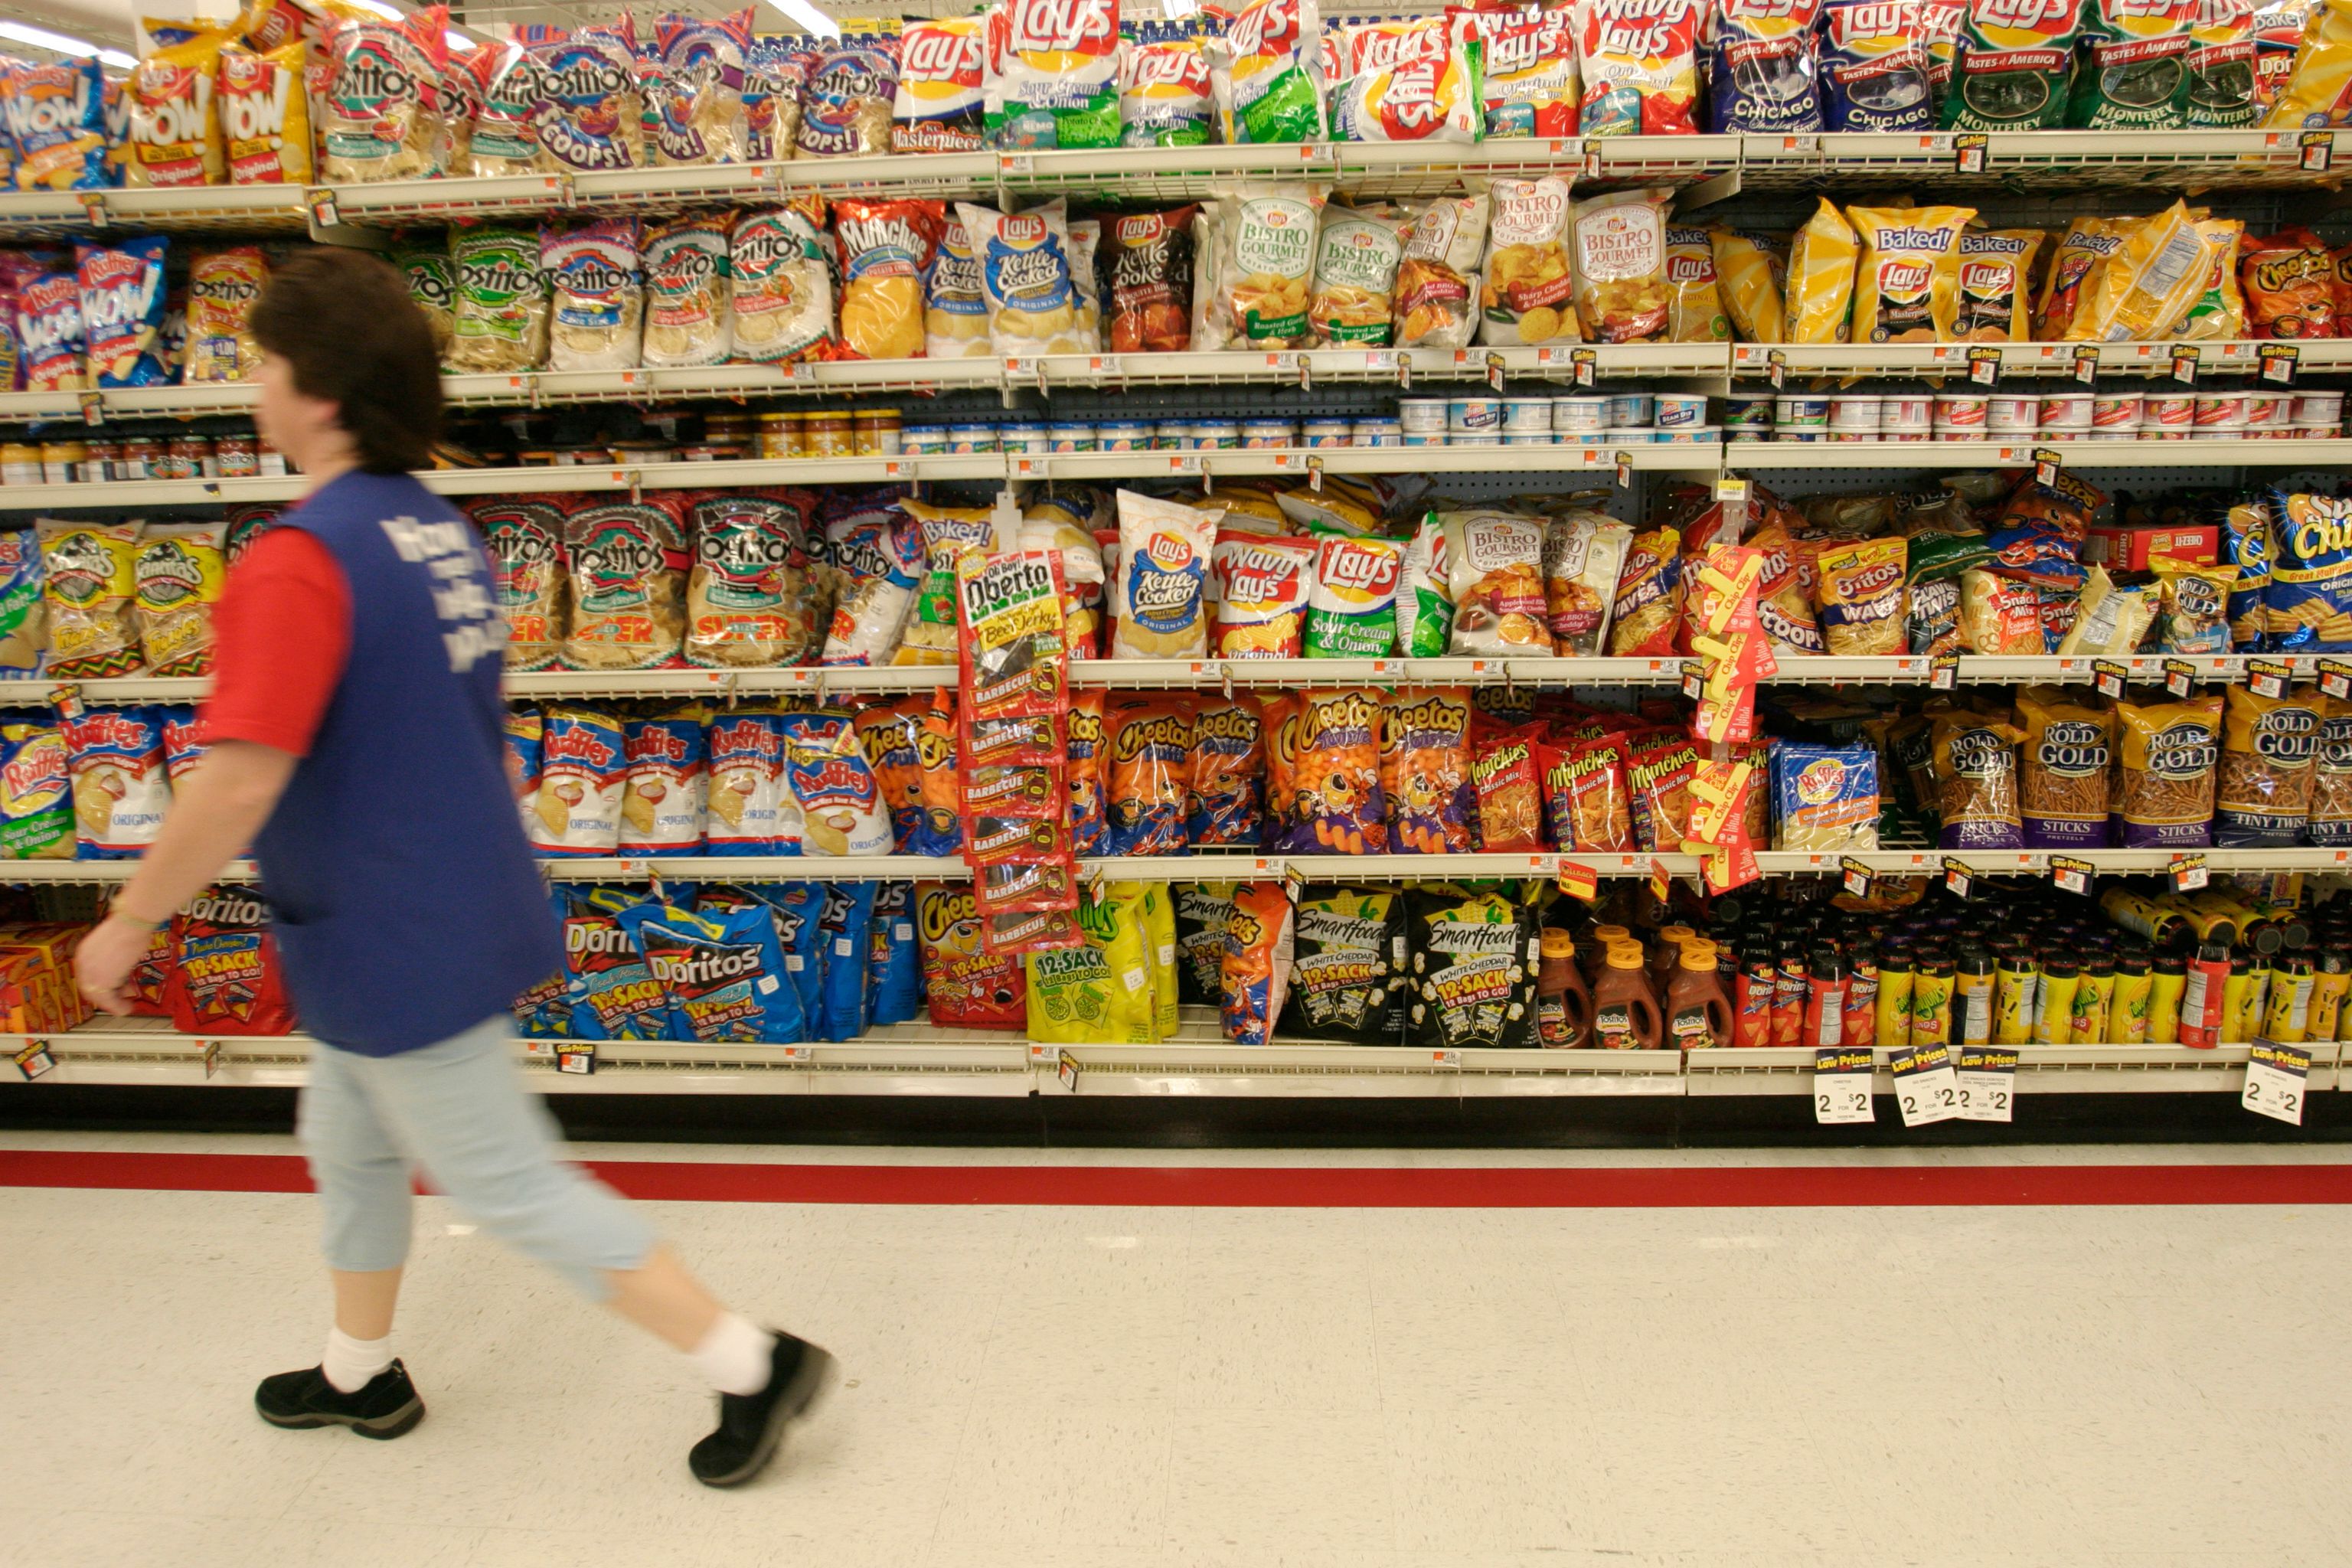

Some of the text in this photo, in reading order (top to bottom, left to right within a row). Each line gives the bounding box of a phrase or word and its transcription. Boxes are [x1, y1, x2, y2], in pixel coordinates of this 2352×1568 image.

[1488, 26, 1557, 75] Lay's
[1600, 21, 1670, 59] Lay's
[1966, 57, 1996, 68] TASTES
[2009, 54, 2055, 65] AMERICA
[1019, 78, 1101, 97] Sour Cream
[1047, 94, 1089, 109] Onion
[1734, 97, 1815, 119] CHICAGO
[1847, 109, 1928, 126] CHICAGO
[2097, 103, 2174, 122] MONTEREY
[147, 164, 203, 185] Original
[1498, 194, 1562, 215] BISTRO
[1495, 211, 1562, 228] GOURMET
[840, 217, 927, 261] Munchos
[1243, 224, 1308, 245] BISTRO
[1877, 227, 1954, 251] Baked!
[1960, 237, 2027, 253] Baked!
[1241, 240, 1306, 260] GOURMET
[1000, 252, 1050, 273] Kettle
[544, 267, 632, 289] Tostitos
[998, 265, 1060, 286] Cooked
[1013, 299, 1060, 309] ORIGINAL
[1517, 289, 1542, 302] Sharp
[1523, 299, 1530, 308] &
[1254, 320, 1283, 330] Roasted
[1278, 326, 1296, 335] Herb
[93, 341, 139, 361] Original
[923, 521, 991, 547] Baked!
[1475, 533, 1537, 546] BISTRO
[567, 542, 665, 573] Tostitos
[1475, 544, 1537, 557] GOURMET
[1721, 557, 1737, 565] Chip
[1001, 559, 1021, 573] Boy!
[1228, 547, 1294, 577] Wavy
[1324, 544, 1396, 588] Lay's
[1720, 564, 1736, 572] Clip
[966, 564, 1048, 608] Oberto
[1837, 563, 1899, 597] Fritos
[2178, 578, 2208, 596] ROLD
[2289, 572, 2313, 581] Great
[1231, 576, 1277, 602] Lay's
[1724, 588, 1740, 609] Chip
[1736, 573, 1751, 594] Clip
[2000, 594, 2036, 606] Snack
[2176, 591, 2216, 614] GOLD
[2013, 606, 2035, 617] Mix
[697, 616, 790, 644] SUPER
[986, 623, 1016, 642] Beef
[1019, 612, 1057, 633] Jerky
[1311, 619, 1390, 640] Sour Cream
[1321, 634, 1378, 652] & Onion
[1722, 635, 1743, 675] Chip Clip
[2249, 662, 2291, 675] Low Prices
[976, 672, 1032, 703] BARBECUE
[2260, 710, 2312, 732] ROLD
[57, 713, 148, 756] Ruffles
[1119, 717, 1191, 761] Cheetos
[2043, 725, 2095, 746] ROLD
[2150, 729, 2201, 752] ROLD
[2256, 730, 2321, 756] GOLD
[544, 726, 613, 766] Ruffles
[1145, 746, 1185, 763] Puffs
[2037, 743, 2109, 767] GOLD
[2148, 745, 2217, 769] GOLD
[797, 761, 868, 794] Ruffles
[1547, 746, 1619, 792] Munchies
[1628, 747, 1700, 794] Munchies
[968, 775, 1024, 799] BARBECUE
[1479, 771, 1521, 794] Classic Mix
[1571, 777, 1598, 794] Classic
[1649, 773, 1690, 796] Classic Mix
[1798, 765, 1845, 795] Ruffles
[1714, 798, 1729, 819] Chip
[1726, 782, 1739, 799] Clip
[2042, 821, 2090, 834] STICKS
[2236, 812, 2269, 827] TINY
[4, 827, 28, 841] Sour
[27, 830, 61, 845] Onion
[974, 825, 1031, 850] BARBECUE
[2158, 823, 2205, 838] STICKS
[2051, 858, 2092, 871] Low Prices
[1295, 909, 1383, 942] Smartfood
[1429, 921, 1518, 948] Smartfood
[188, 952, 257, 976] 12-SACK
[651, 952, 760, 984] Doritos
[950, 956, 1007, 977] 12-SACK
[1036, 950, 1108, 976] 12-SACK
[1307, 952, 1373, 968] WHITE CHEDDAR
[1440, 958, 1508, 982] WHITE CHEDDAR
[1044, 977, 1054, 985] 12
[1056, 975, 1076, 985] Bags
[1077, 970, 1092, 979] TO
[1302, 963, 1372, 985] 12-SACK
[1436, 969, 1508, 995] 12-SACK
[588, 982, 664, 1011] 12-SACK
[1446, 1000, 1455, 1008] 12
[1456, 995, 1476, 1005] Bags
[1491, 987, 1509, 996] GO!
[1818, 1055, 1872, 1070] Low Prices
[1892, 1051, 1947, 1072] Low Prices
[1962, 1054, 2014, 1066] Low Prices
[2252, 1047, 2309, 1067] Low Prices
[1819, 1095, 1831, 1112] 2
[1849, 1093, 1867, 1111] $2
[1903, 1096, 1918, 1115] 2
[1935, 1088, 1955, 1107] $2
[1960, 1090, 1970, 1107] 2
[1989, 1091, 2007, 1109] $2
[2246, 1083, 2260, 1100] 2
[2278, 1091, 2297, 1112] $2
